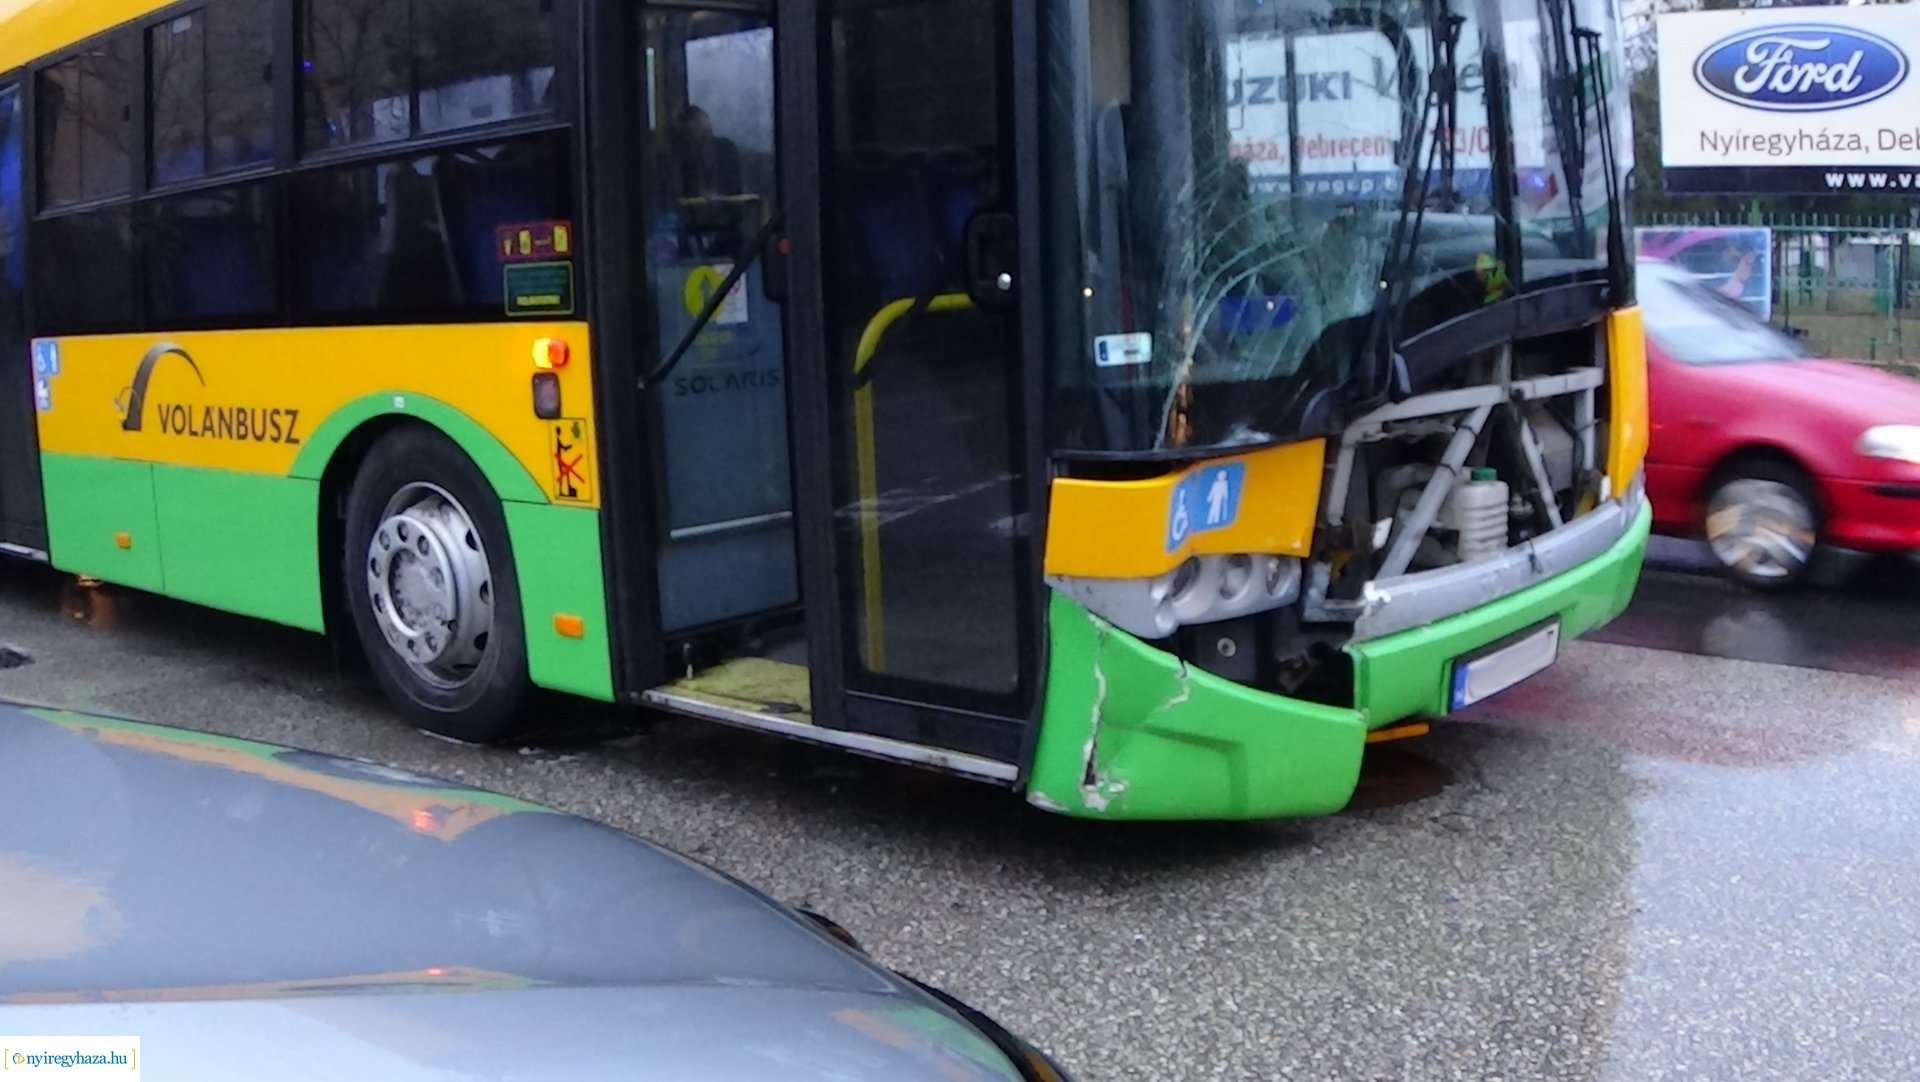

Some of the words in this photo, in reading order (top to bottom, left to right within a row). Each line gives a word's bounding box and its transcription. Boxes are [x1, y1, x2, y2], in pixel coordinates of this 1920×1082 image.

[1734, 36, 1865, 93] Ford
[1700, 127, 1870, 155] Nyíregyháza,
[674, 368, 780, 396] SOLARIS
